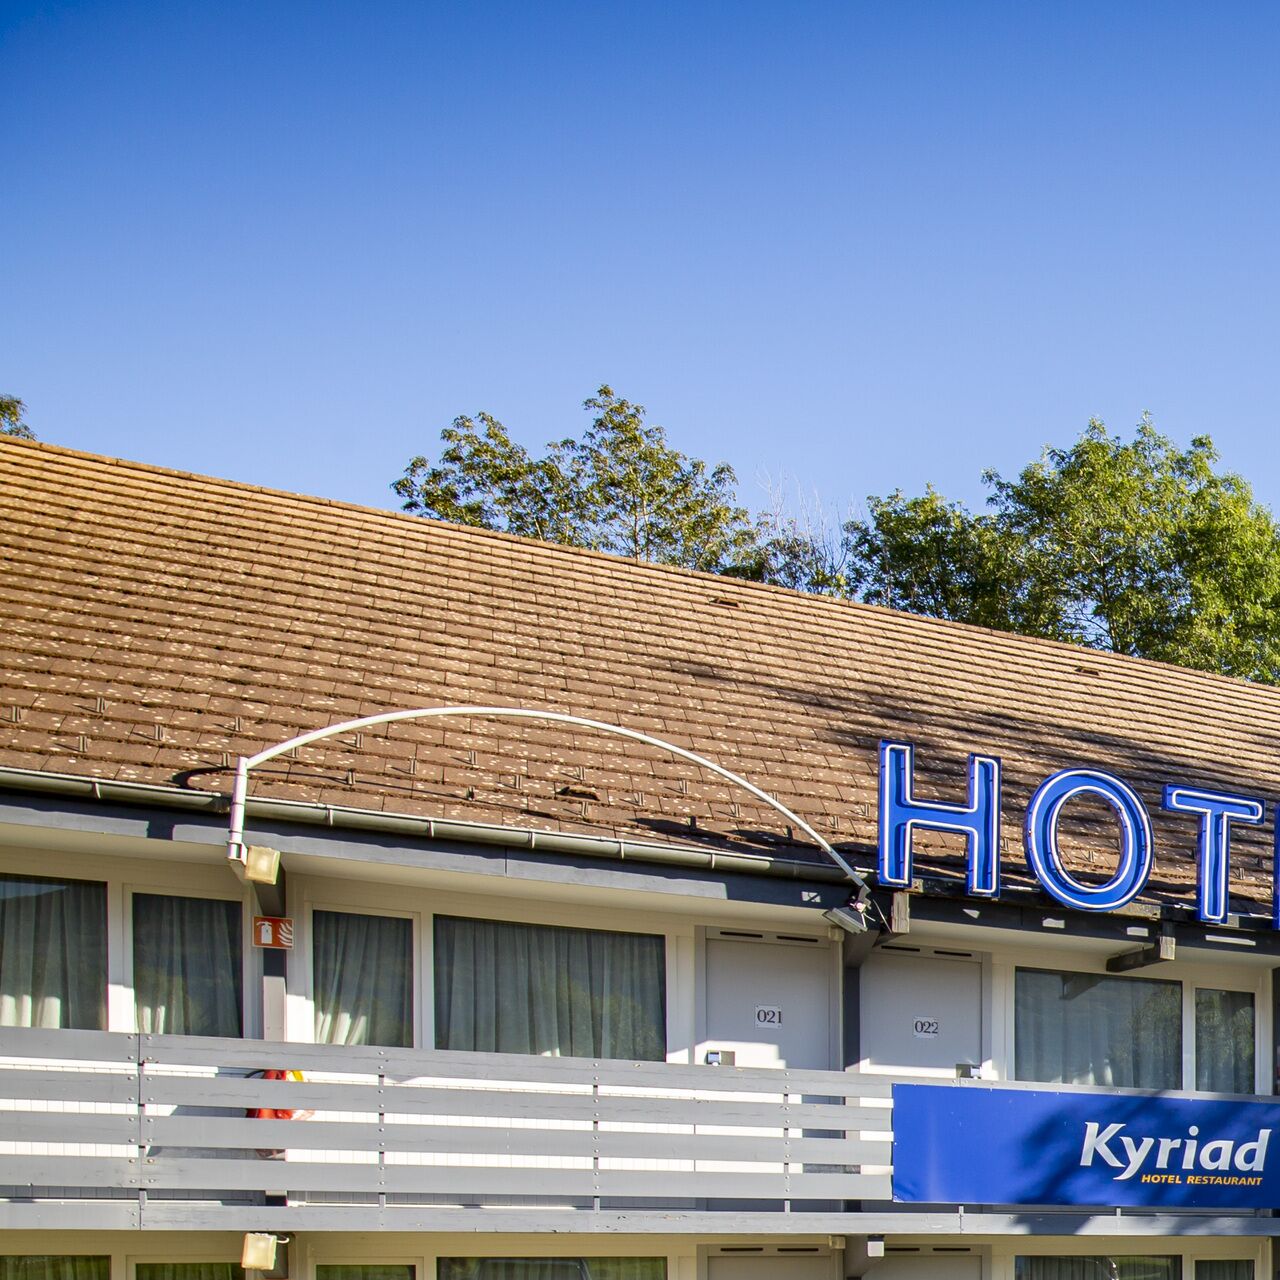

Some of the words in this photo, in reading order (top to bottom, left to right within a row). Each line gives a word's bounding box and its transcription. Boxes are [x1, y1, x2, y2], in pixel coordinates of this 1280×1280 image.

[757, 1009, 782, 1024] 021
[914, 1020, 939, 1034] 022
[1079, 1121, 1272, 1181] Kyriad
[1141, 1174, 1182, 1184] HOTEL
[1186, 1175, 1263, 1186] RESTAURANT
